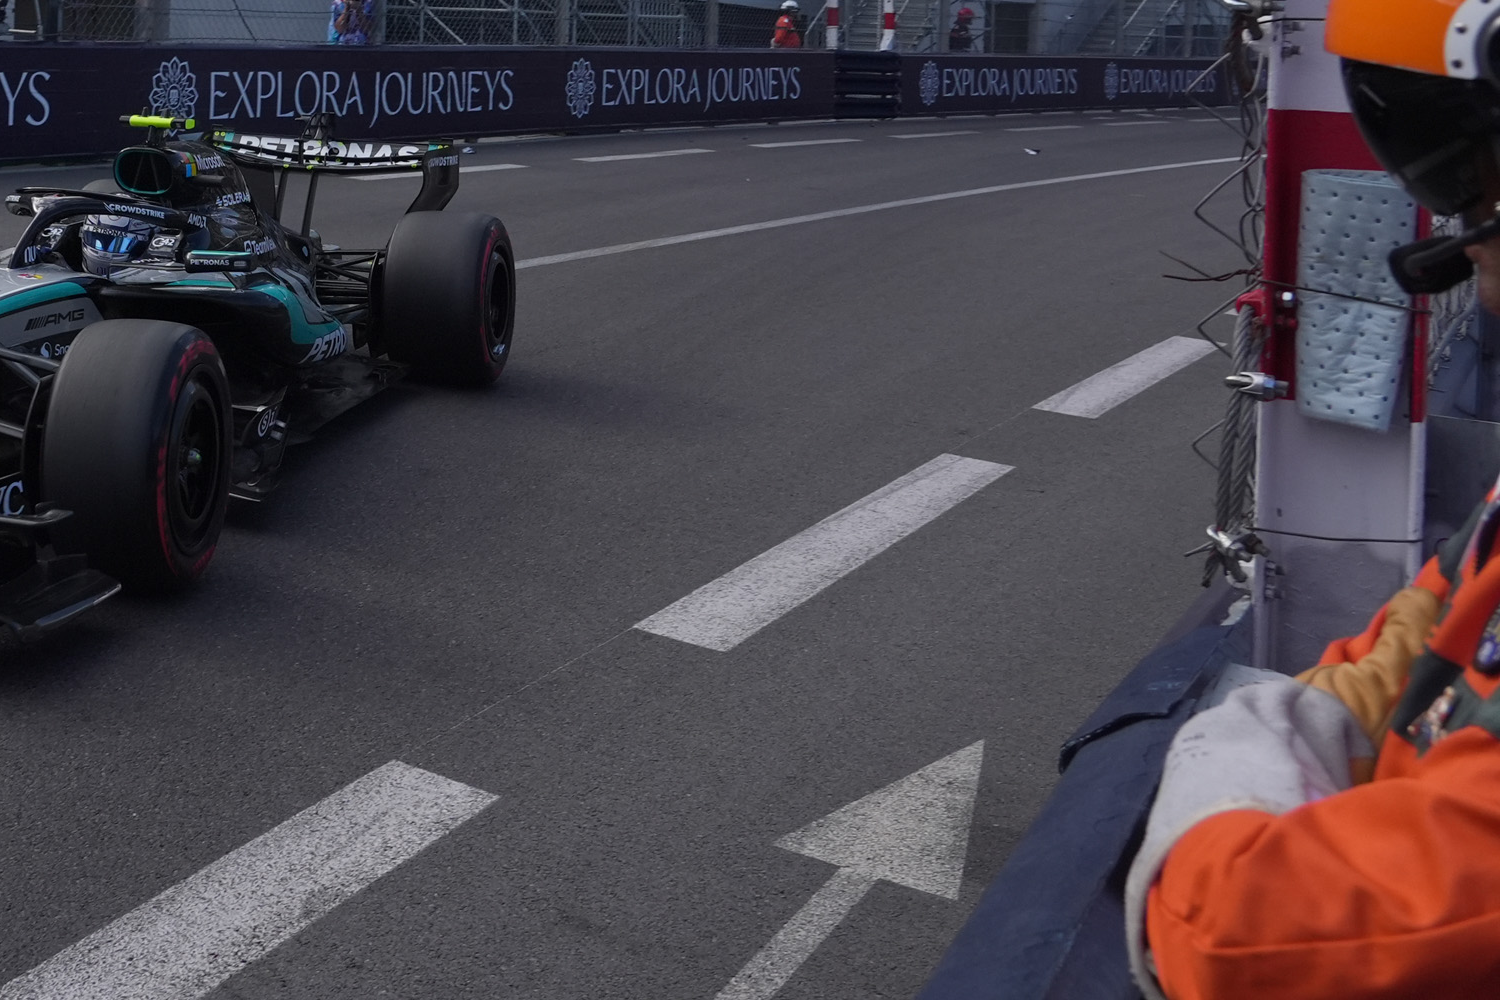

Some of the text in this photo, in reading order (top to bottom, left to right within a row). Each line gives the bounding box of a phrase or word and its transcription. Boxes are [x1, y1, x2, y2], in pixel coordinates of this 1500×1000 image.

[602, 67, 801, 113] EXPLORA JOURNEYS
[942, 68, 1078, 103] EXPLORA JOURNEYS
[1120, 68, 1168, 94] EXPLORA
[209, 69, 514, 128] EXPLORA JOURNEYS
[237, 135, 420, 167] PETRONAS
[108, 203, 165, 219] CROWDSTRIKE
[152, 237, 175, 248] G42
[190, 258, 230, 268] PETRONAS
[45, 308, 84, 325] AMG
[308, 330, 347, 362] PETRO
